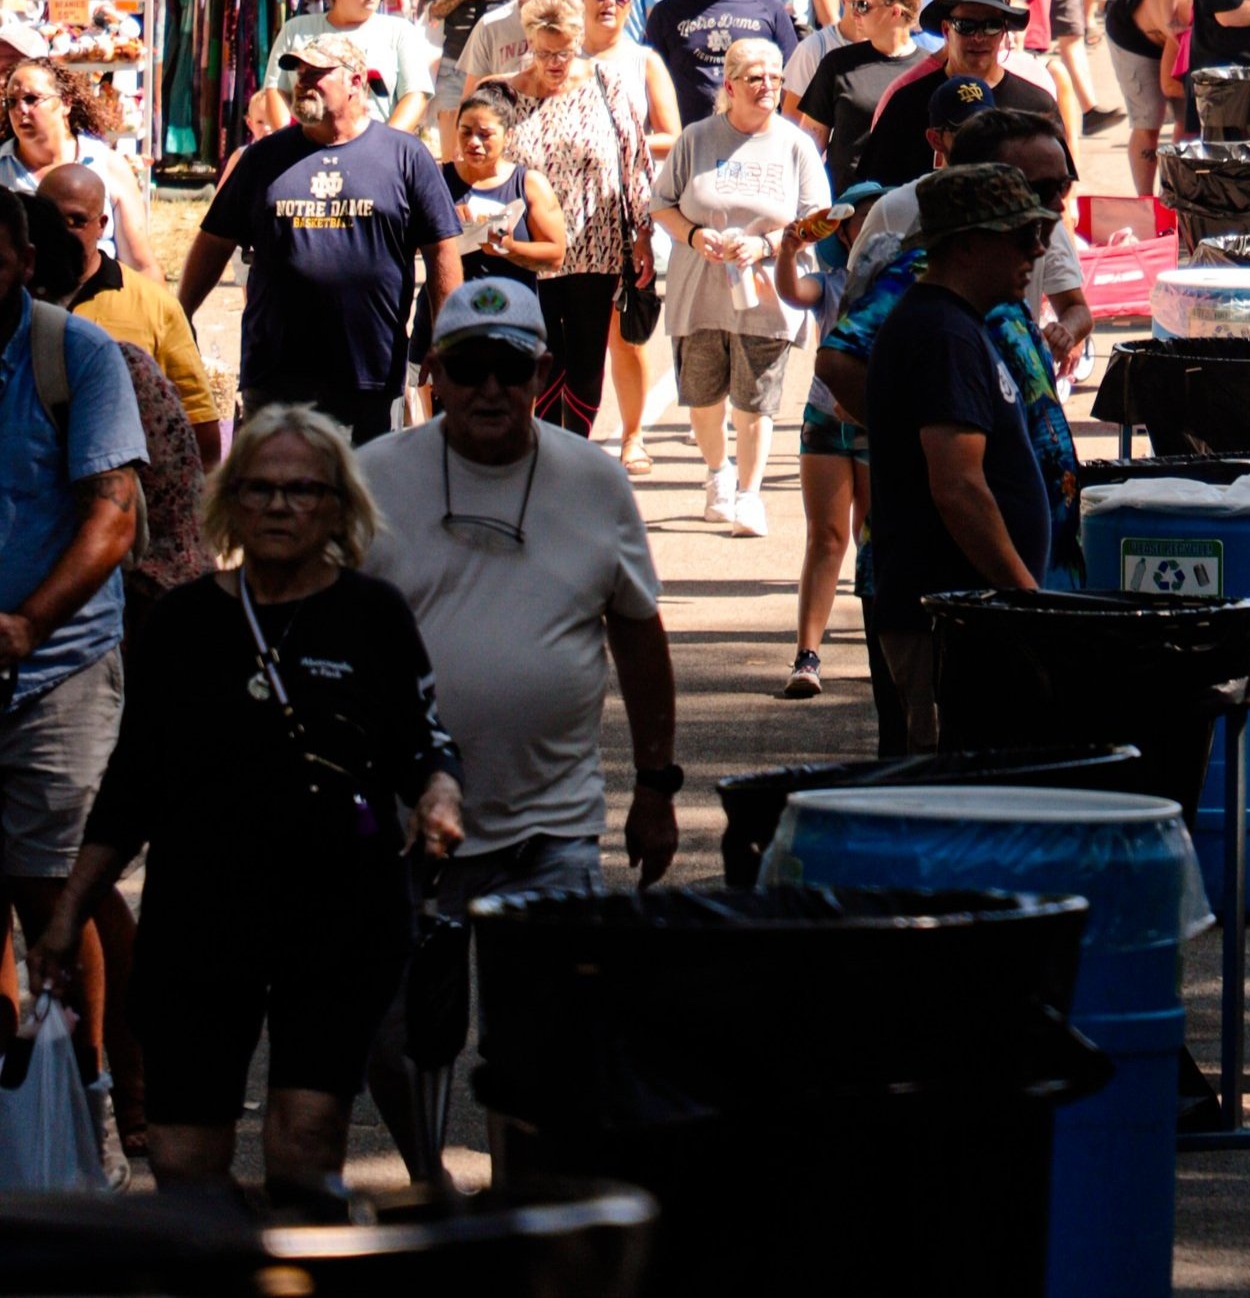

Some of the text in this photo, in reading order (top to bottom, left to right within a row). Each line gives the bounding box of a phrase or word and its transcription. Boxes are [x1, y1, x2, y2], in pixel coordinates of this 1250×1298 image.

[677, 13, 762, 38] Notre Dame
[715, 158, 786, 202] USA
[275, 199, 374, 217] NOTRE DAME
